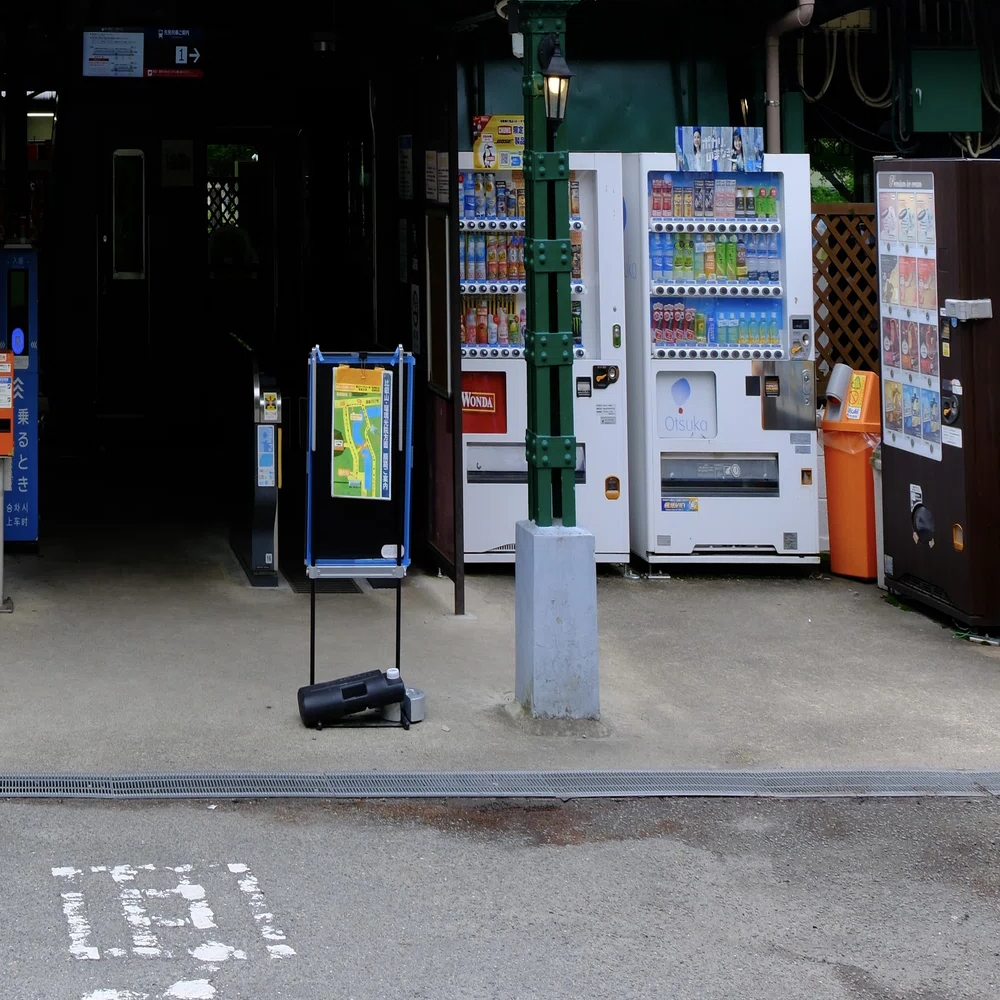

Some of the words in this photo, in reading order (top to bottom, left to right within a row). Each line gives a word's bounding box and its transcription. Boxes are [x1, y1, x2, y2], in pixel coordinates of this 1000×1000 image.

[179, 48, 184, 61] 1
[665, 416, 708, 431] Otsuka
[17, 408, 29, 492] 乗るとき
